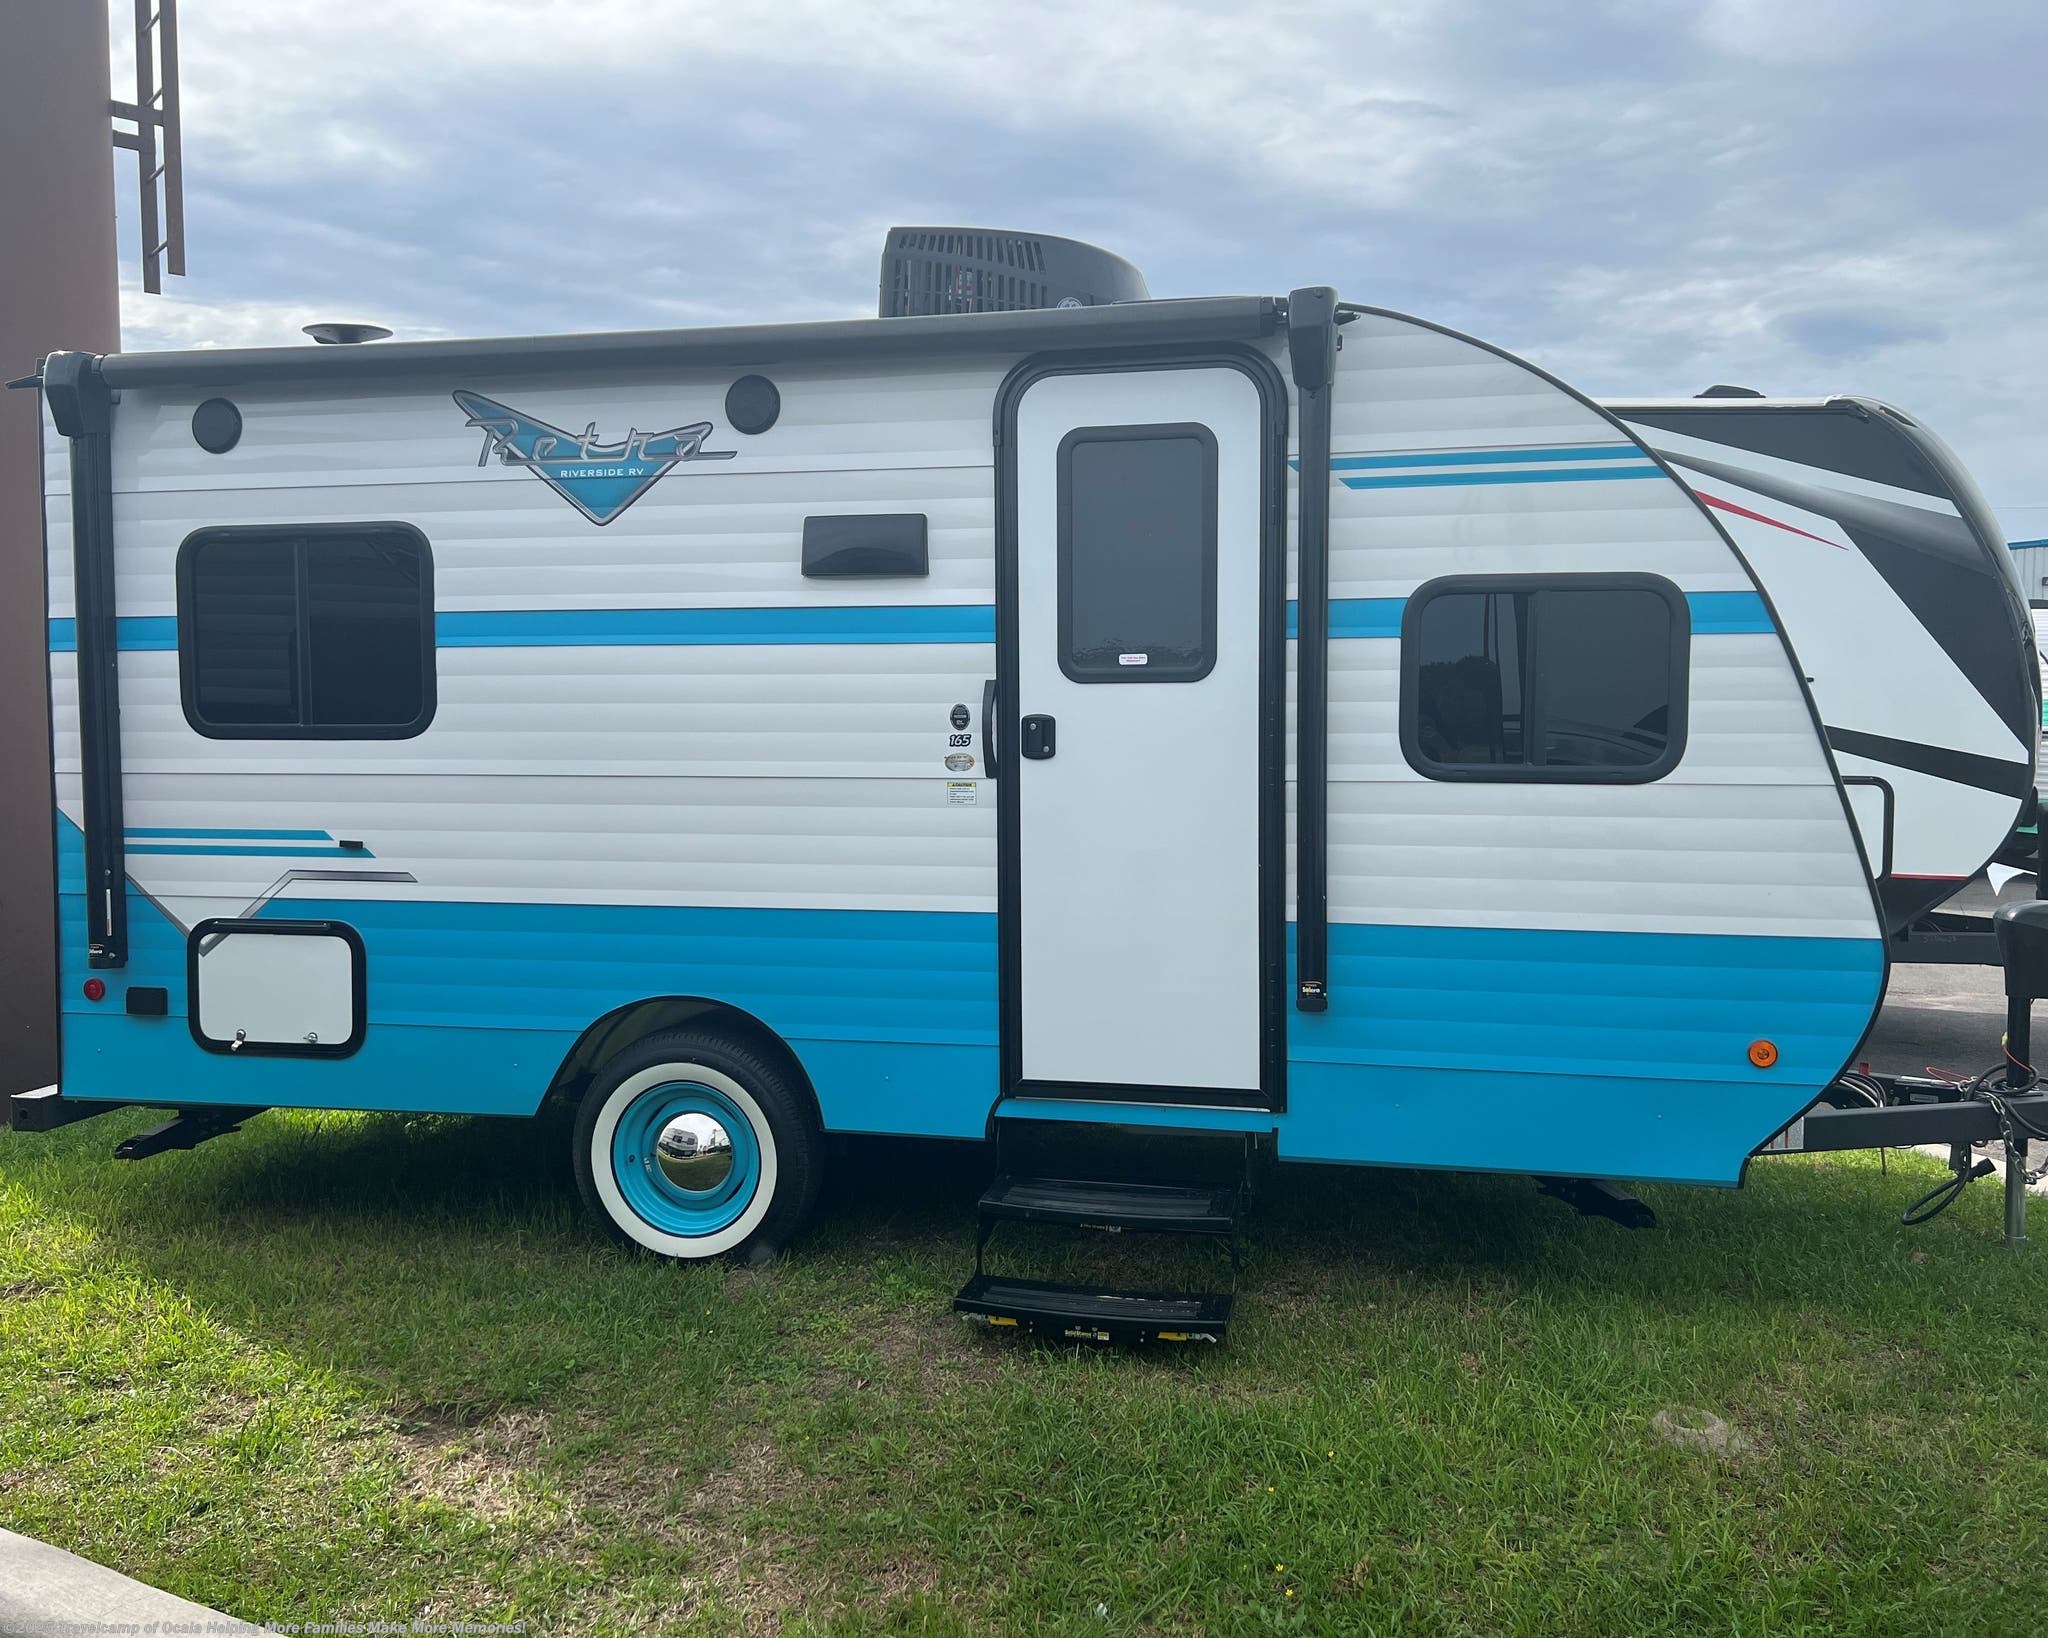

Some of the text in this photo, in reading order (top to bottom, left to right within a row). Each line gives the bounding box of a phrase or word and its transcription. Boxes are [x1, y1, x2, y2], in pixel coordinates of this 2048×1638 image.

[465, 418, 737, 467] Retro
[560, 467, 644, 478] RIVERSIDE RV
[949, 734, 971, 747] 165
